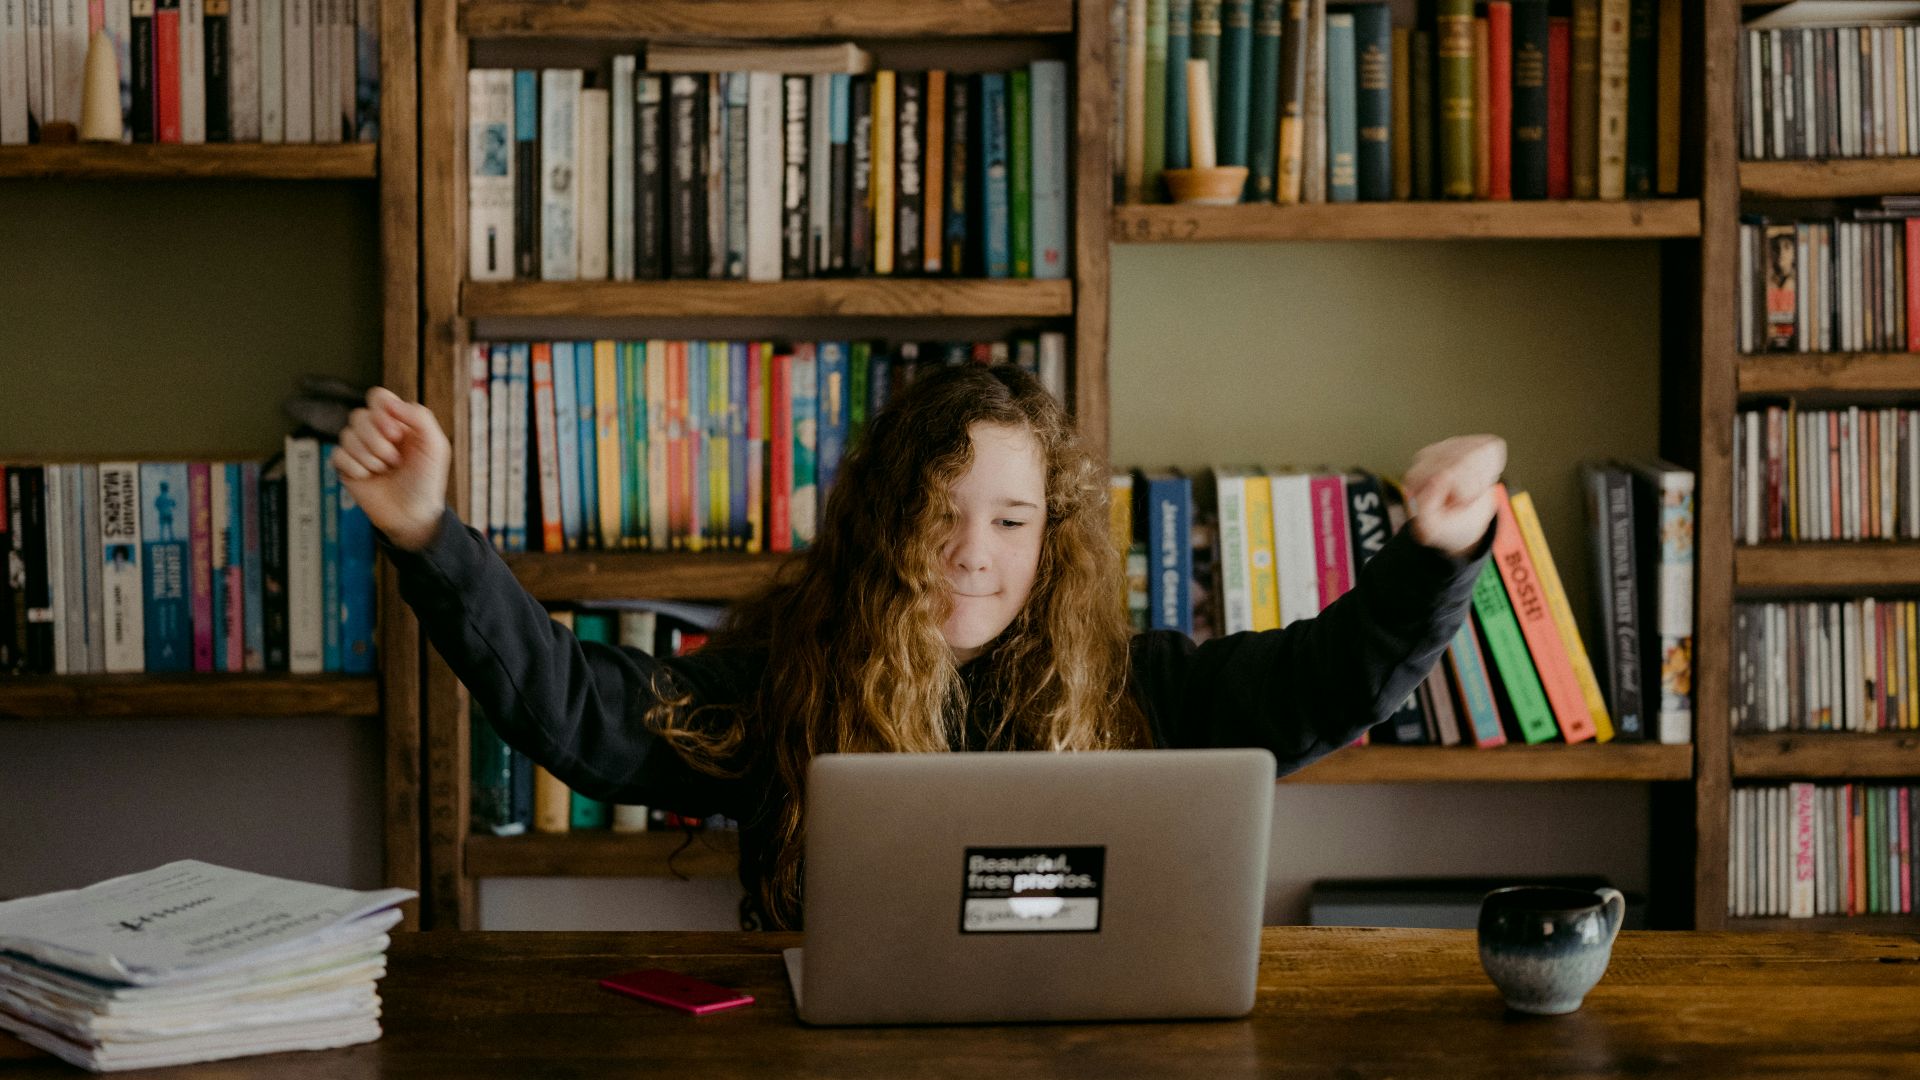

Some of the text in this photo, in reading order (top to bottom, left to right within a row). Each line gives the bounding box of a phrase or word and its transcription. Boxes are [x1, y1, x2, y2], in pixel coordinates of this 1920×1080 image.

[103, 471, 121, 537] MARKS
[122, 471, 136, 536] HOWARD
[1353, 491, 1386, 564] SAV
[1161, 499, 1179, 626] JAMIE'S GREAT
[1505, 549, 1544, 621] BOSH!
[969, 854, 1071, 873] Beautiful,
[1796, 784, 1814, 881] RAMONES
[968, 873, 1097, 893] free photos.
